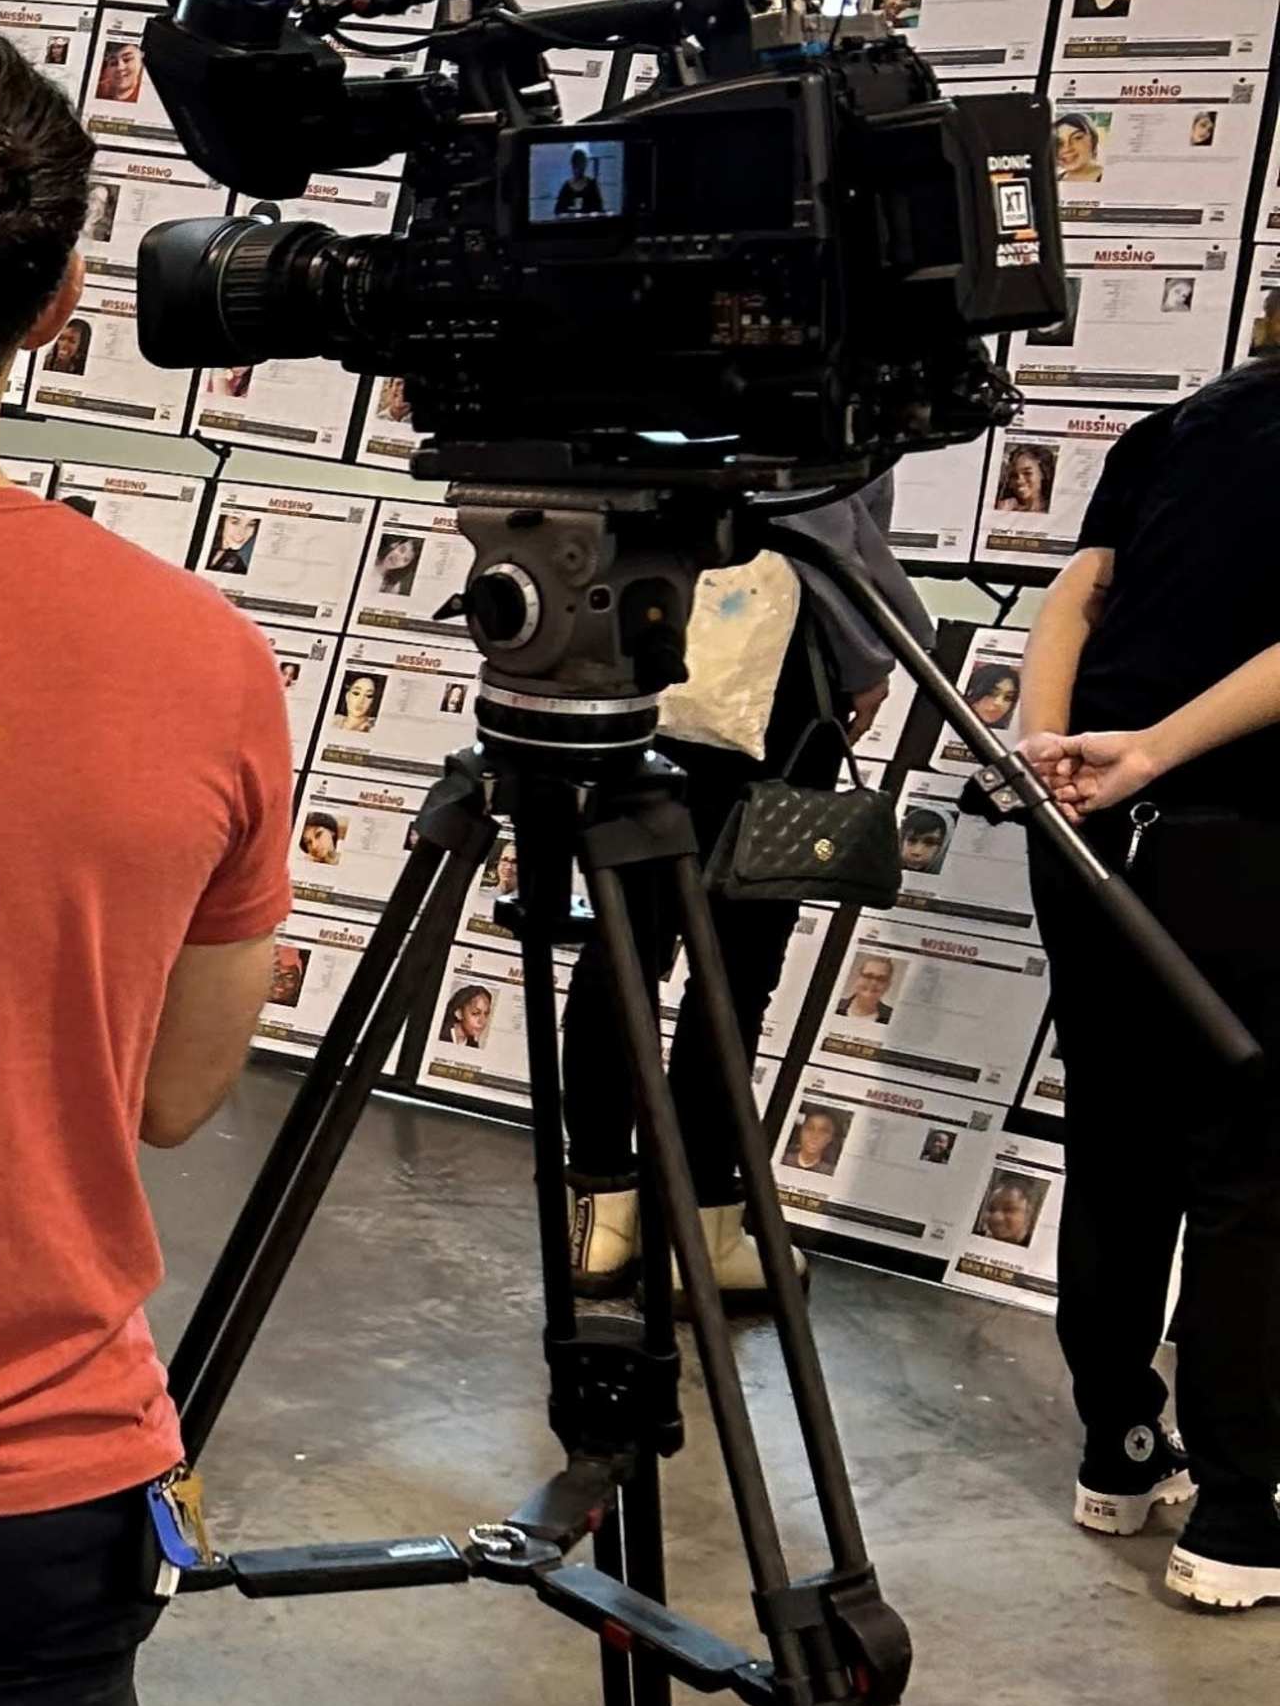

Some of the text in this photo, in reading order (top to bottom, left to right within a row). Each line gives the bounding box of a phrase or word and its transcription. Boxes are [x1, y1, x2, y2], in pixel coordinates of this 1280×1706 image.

[1120, 85, 1181, 96] MISSING
[987, 154, 1032, 172] DIONIC
[127, 164, 172, 177] MISSING
[1005, 192, 1022, 212] XT
[996, 241, 1040, 254] ANTON
[1094, 250, 1155, 262] MISSING
[101, 299, 137, 311] MISSIN
[1068, 419, 1127, 433] MISSING
[269, 498, 313, 512] MISSING
[396, 654, 441, 667] MISSING
[359, 792, 404, 806] MISSING
[319, 929, 364, 945] MISSING
[920, 936, 978, 958] MISSING
[866, 1089, 924, 1109] MISSING
